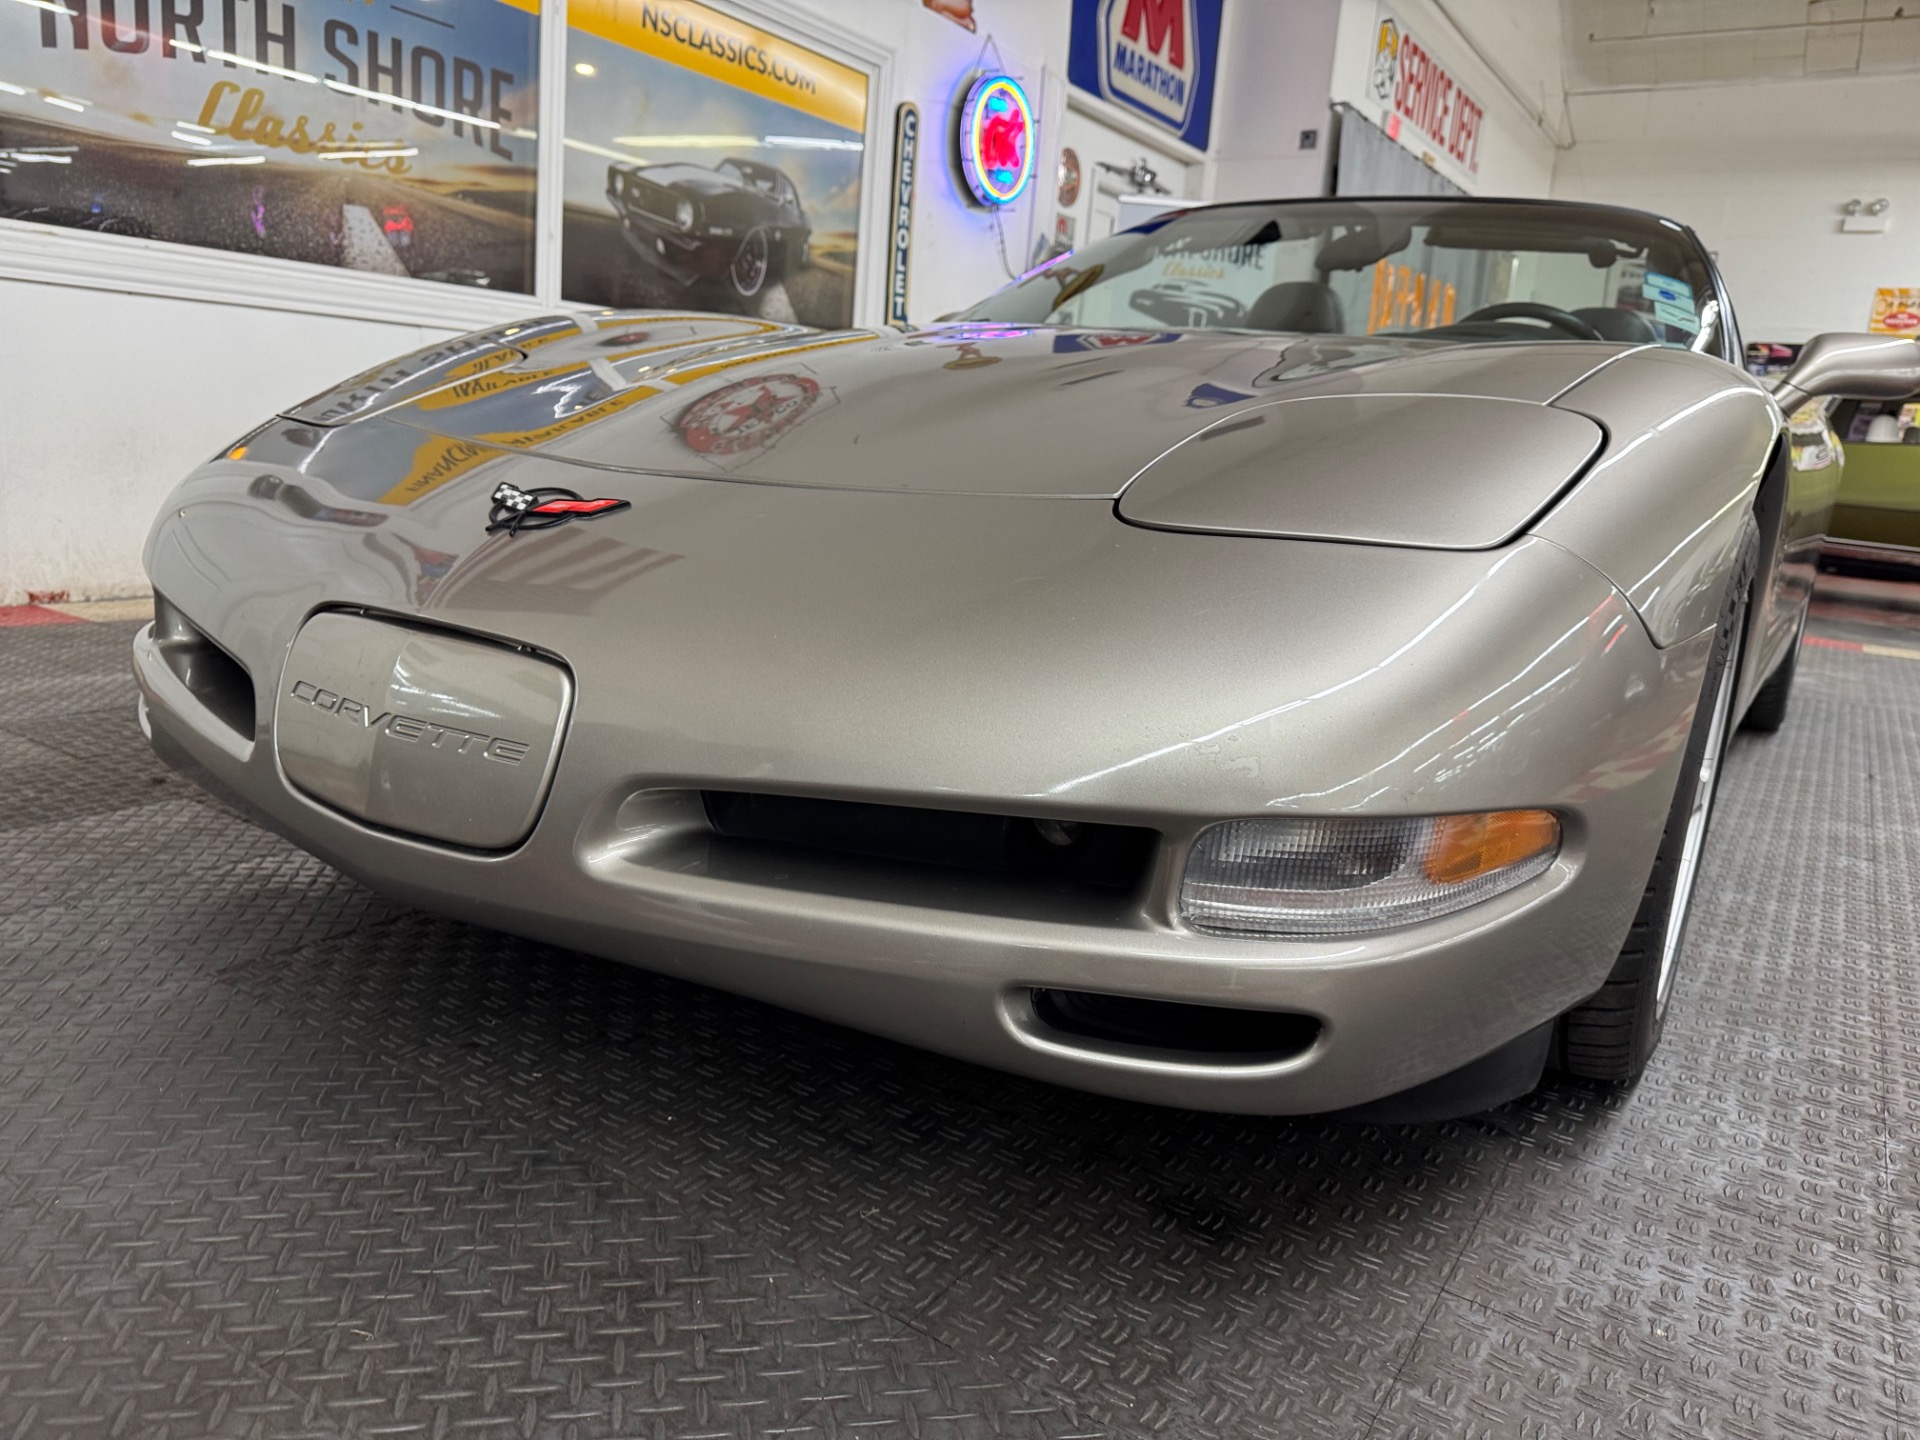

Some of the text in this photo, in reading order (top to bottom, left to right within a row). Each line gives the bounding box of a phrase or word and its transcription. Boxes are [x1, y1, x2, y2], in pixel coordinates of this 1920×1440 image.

[323, 19, 514, 162] SHORE
[642, 3, 817, 95] NSCLASSICS.COM
[1113, 41, 1185, 107] MARATHON
[1395, 34, 1453, 147] SERVICE
[198, 80, 413, 174] Classics
[894, 111, 917, 317] CHEVROLET
[291, 680, 530, 767] CORVETTE
